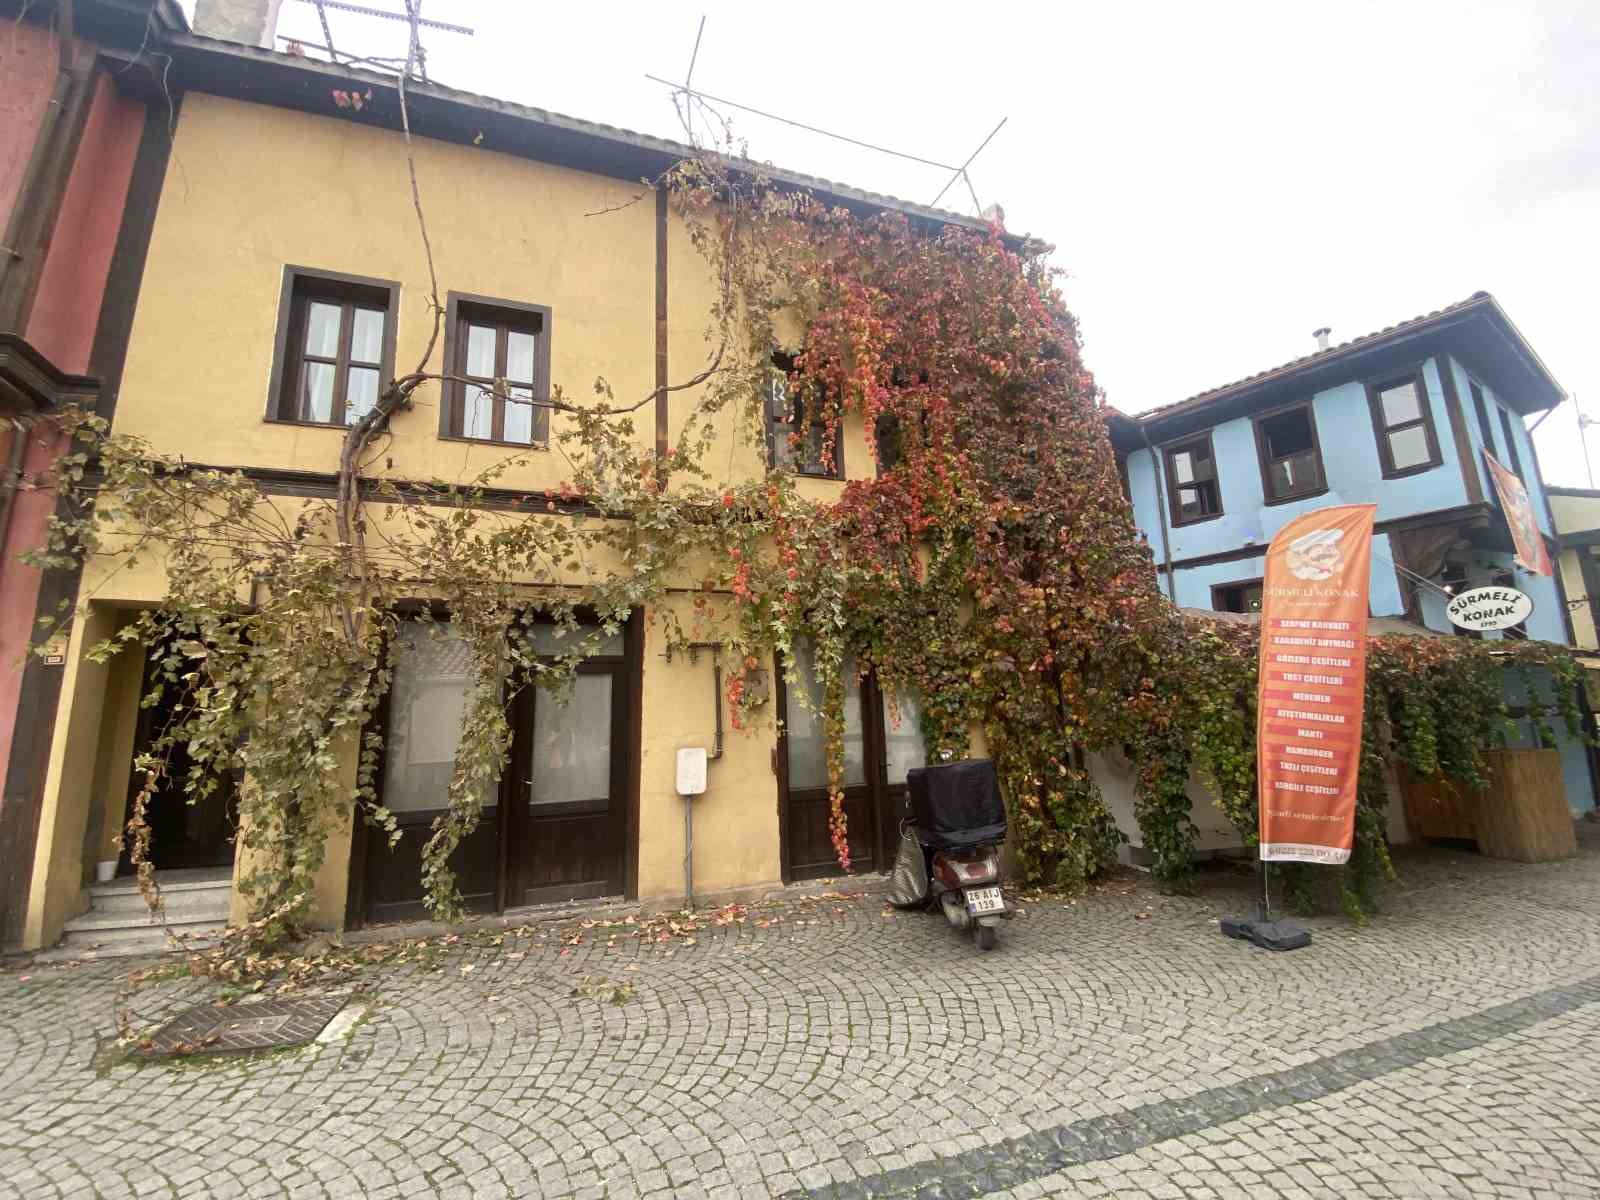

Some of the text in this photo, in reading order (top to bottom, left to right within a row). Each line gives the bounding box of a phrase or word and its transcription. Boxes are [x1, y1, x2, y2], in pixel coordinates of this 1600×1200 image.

[1450, 591, 1522, 615] SÜRMELİ
[1463, 605, 1515, 622] KONAK
[969, 892, 980, 901] 26
